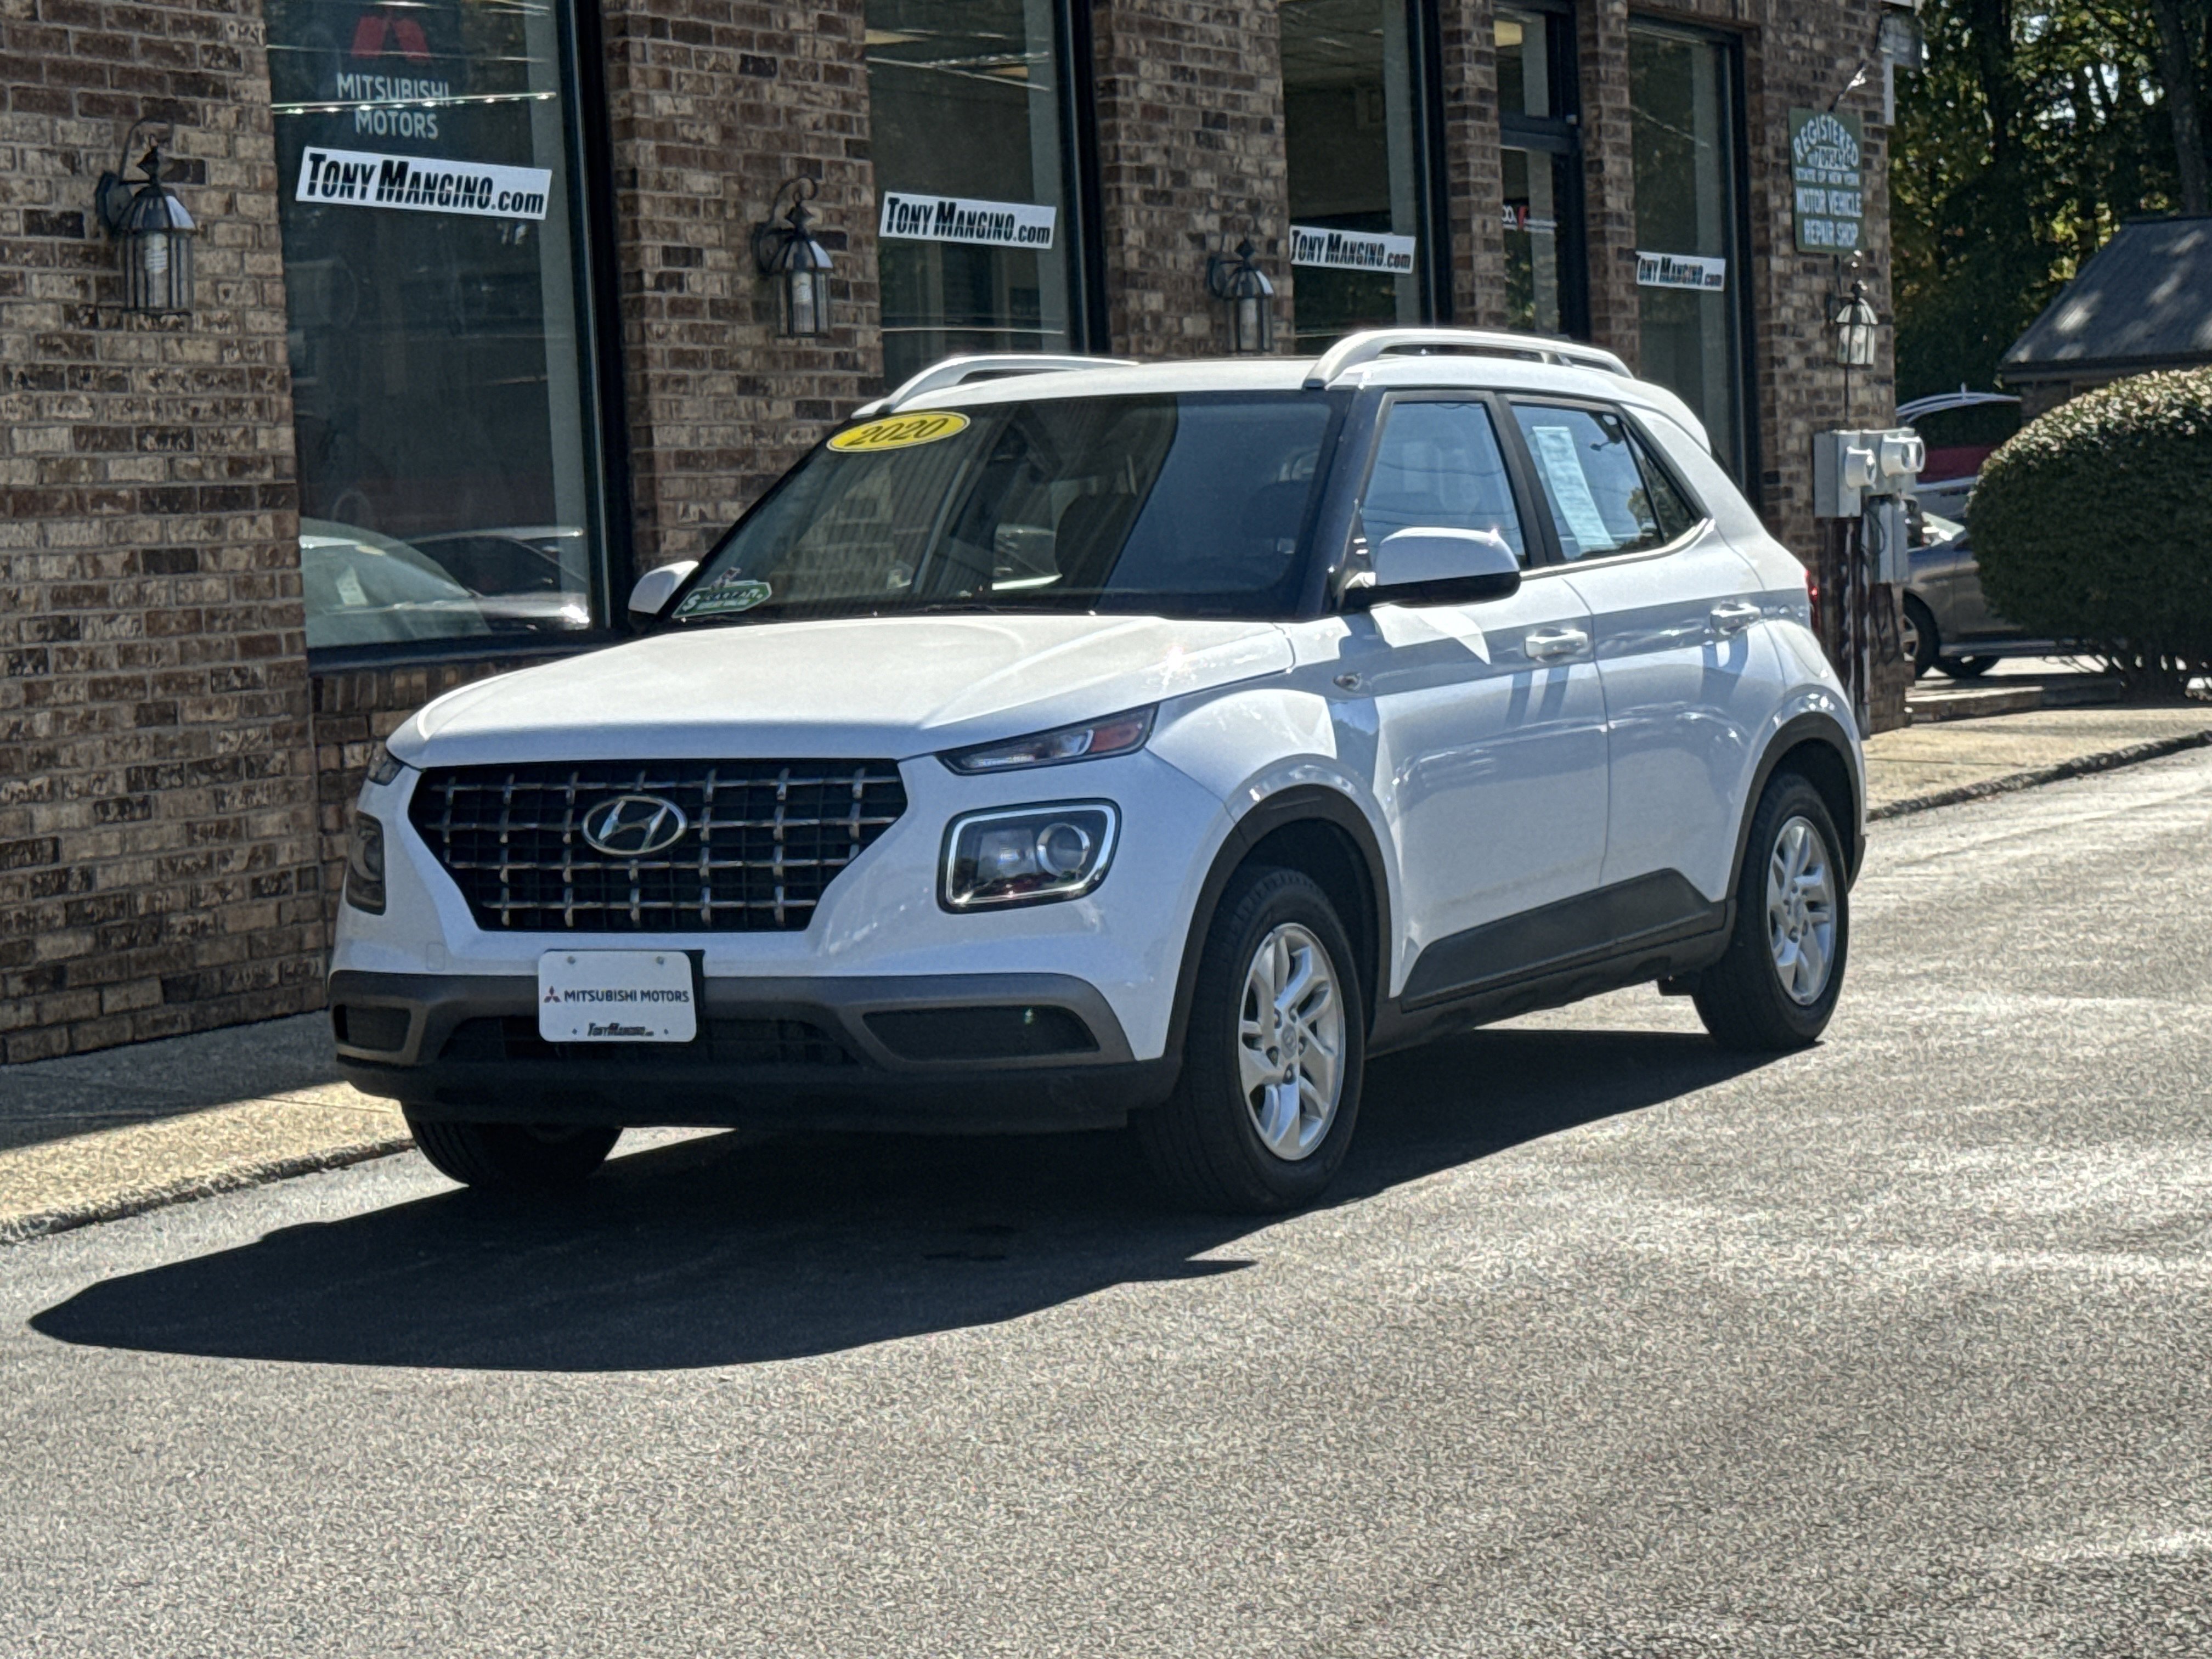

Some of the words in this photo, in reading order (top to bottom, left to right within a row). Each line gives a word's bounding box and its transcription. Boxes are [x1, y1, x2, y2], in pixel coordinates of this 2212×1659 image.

[336, 72, 451, 108] MITSUBISHI
[355, 110, 438, 139] MOTORS
[843, 418, 949, 447] 2020
[563, 990, 637, 1002] MITSUBISHI
[640, 990, 690, 1003] MOTORS
